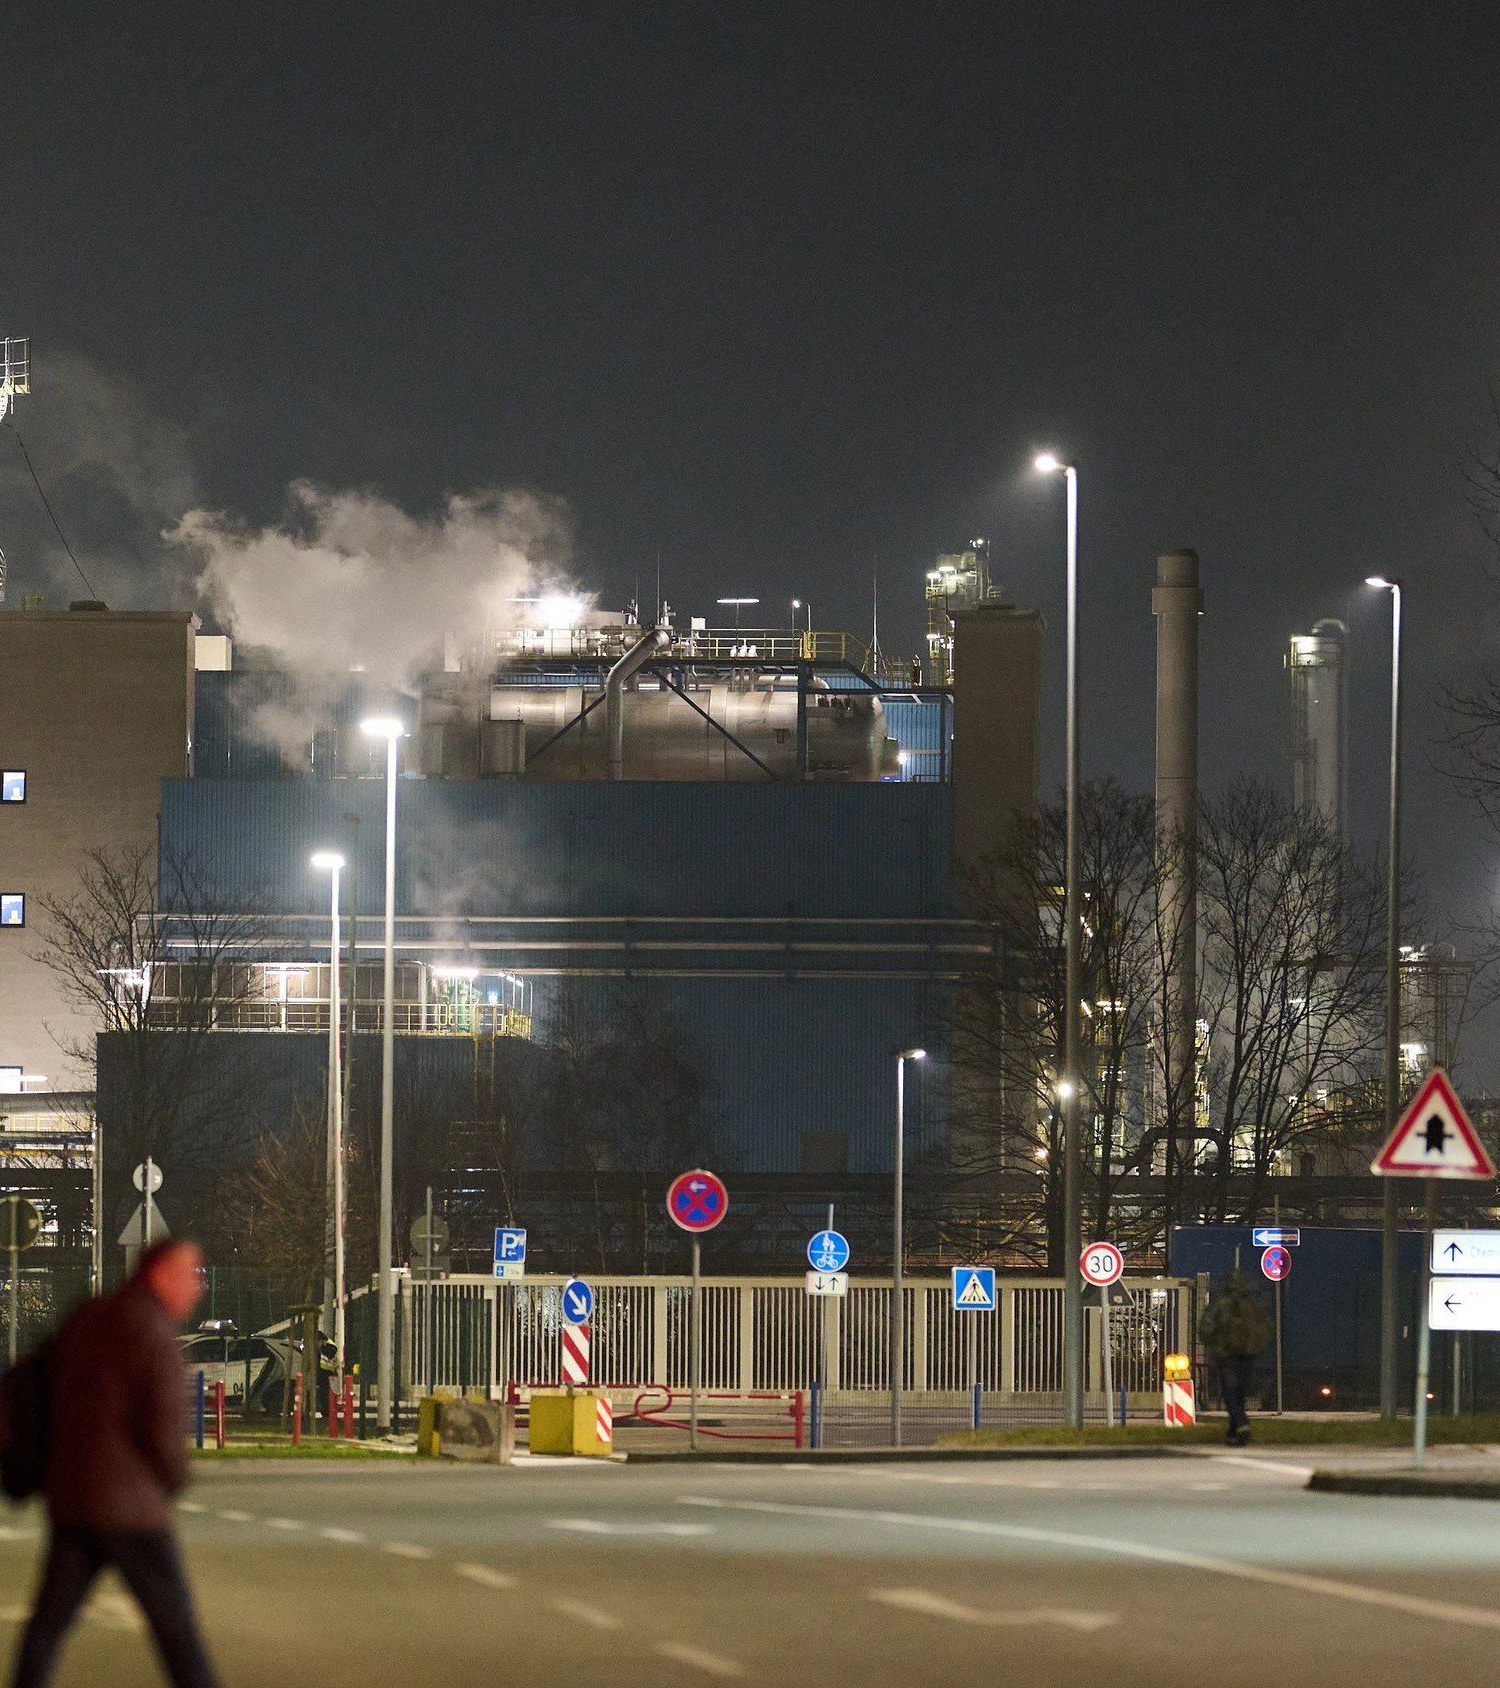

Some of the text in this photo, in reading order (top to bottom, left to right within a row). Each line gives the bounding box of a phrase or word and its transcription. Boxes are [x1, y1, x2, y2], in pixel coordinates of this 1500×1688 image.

[502, 1233, 518, 1258] P
[1090, 1255, 1113, 1273] 30
[233, 1383, 244, 1395] 04
